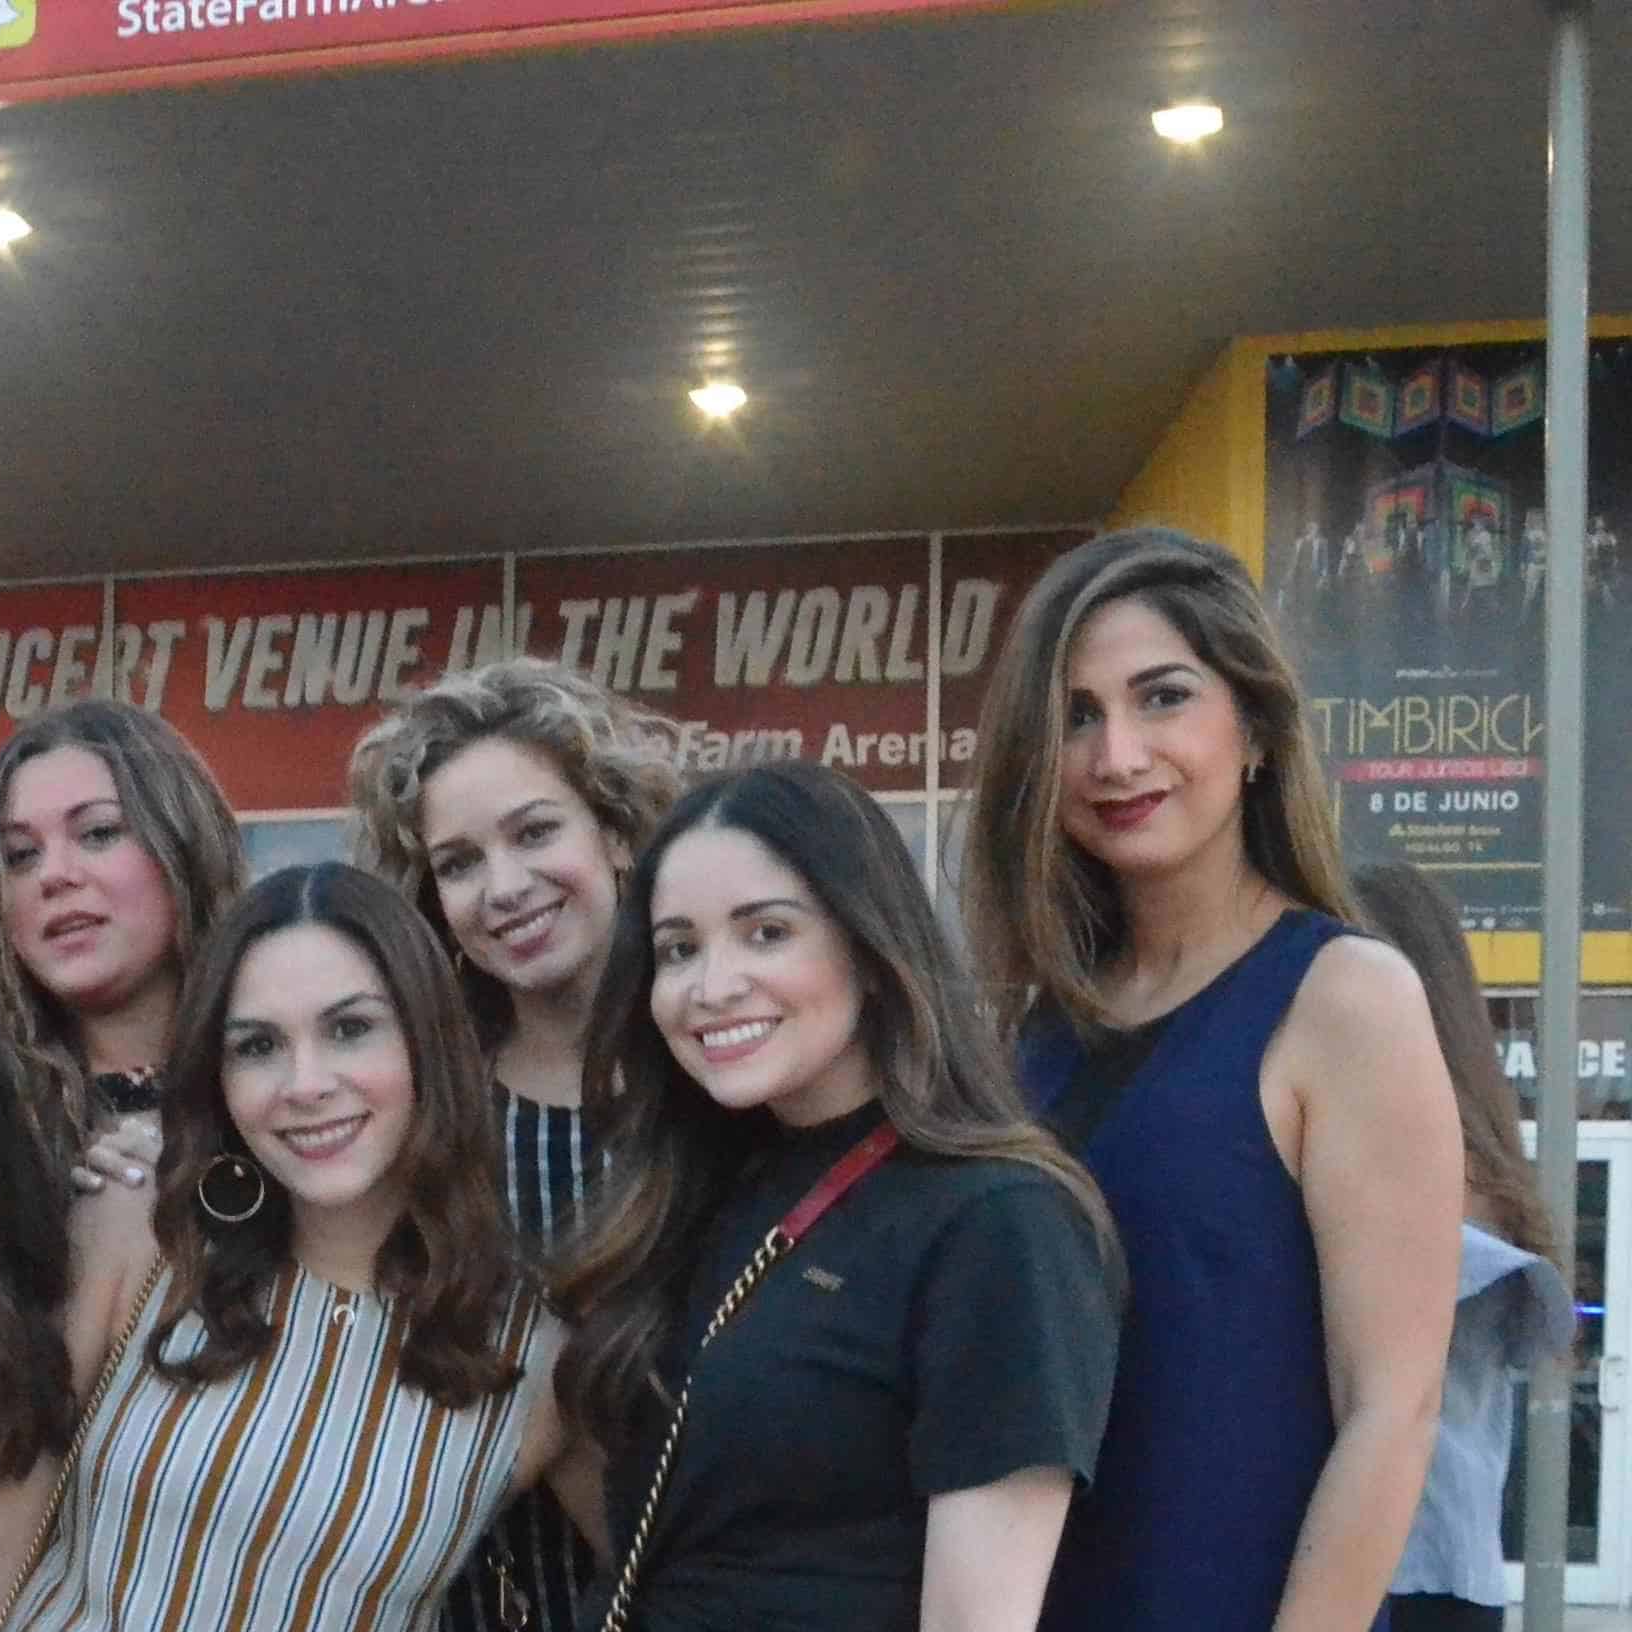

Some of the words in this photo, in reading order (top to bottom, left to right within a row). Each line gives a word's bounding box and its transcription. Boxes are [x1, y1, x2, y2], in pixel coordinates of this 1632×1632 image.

[202, 608, 429, 712] VENUE
[559, 588, 698, 691] THE
[714, 578, 1002, 688] WORLD
[1394, 791, 1428, 812] DE
[1439, 790, 1519, 811] JUNIO
